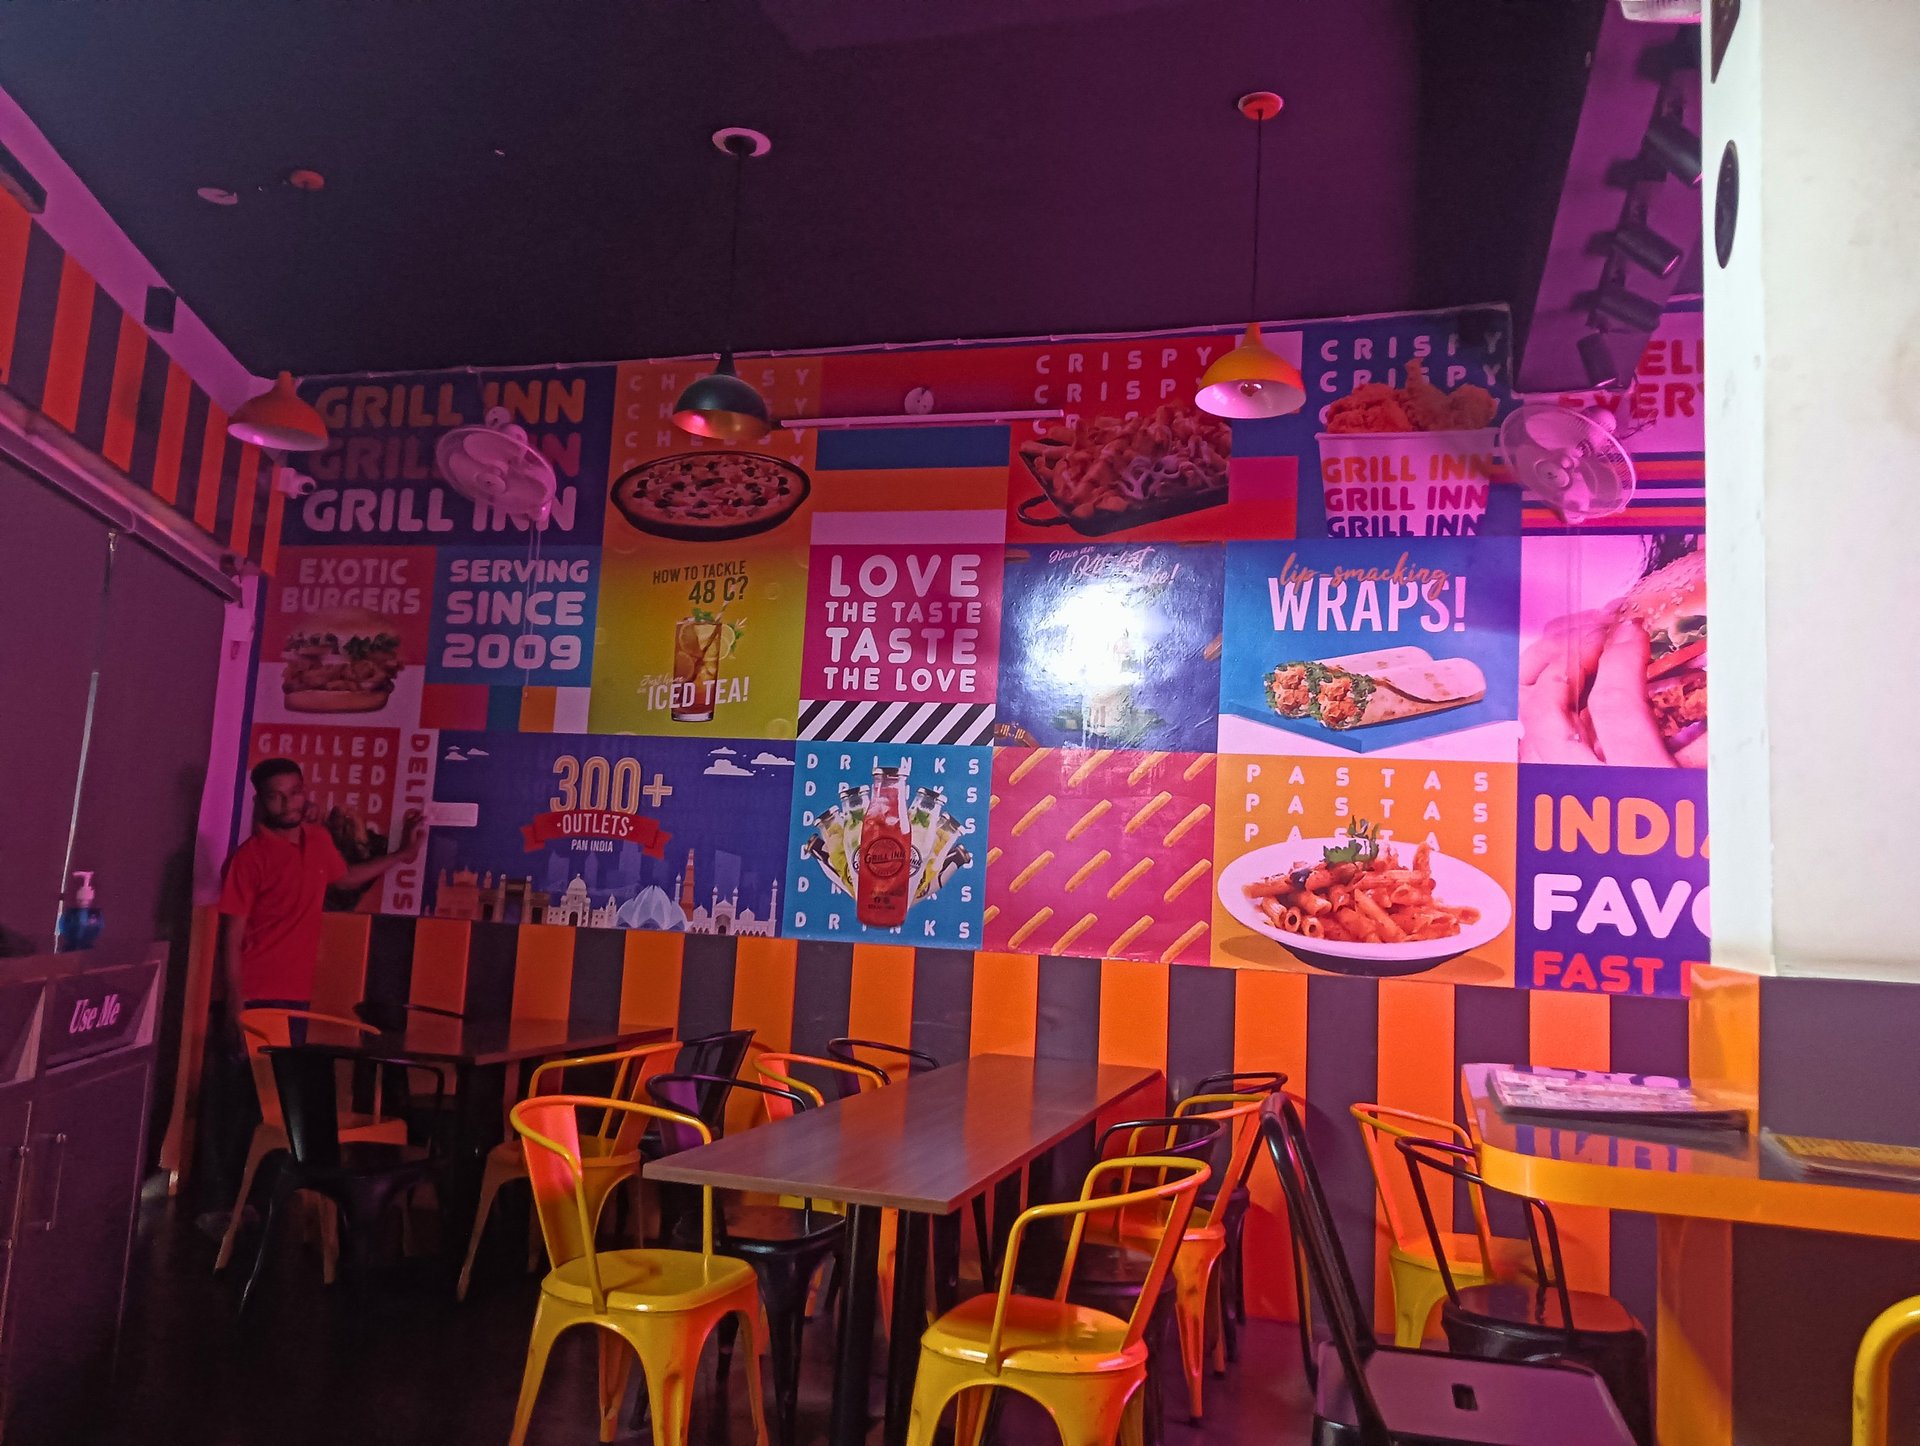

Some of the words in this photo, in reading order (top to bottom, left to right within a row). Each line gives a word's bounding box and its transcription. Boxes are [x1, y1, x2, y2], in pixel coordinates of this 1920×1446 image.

[1036, 346, 1212, 375] CRISPY
[630, 368, 809, 392] CHSY
[1034, 378, 1203, 405] CRISP
[314, 382, 464, 430] GRILL
[1323, 455, 1416, 483] GRILL
[1429, 453, 1493, 481] INN
[303, 487, 454, 533] GRILL
[1325, 486, 1415, 512] GRILL
[1426, 484, 1489, 510] INN
[1327, 515, 1414, 537] GRILL
[1425, 513, 1487, 537] INN
[1049, 549, 1079, 564] Have
[1080, 545, 1096, 555] an
[299, 558, 409, 586] EXOTIC
[449, 559, 590, 583] SERVING
[652, 568, 681, 585] HOW
[684, 565, 699, 581] TO
[702, 560, 747, 579] TACKLE
[829, 554, 981, 598] LOVE
[1279, 551, 1450, 601] lip-smacking
[280, 586, 421, 616] BURGERS
[688, 579, 716, 604] 48
[723, 575, 749, 602] C?
[1268, 576, 1467, 633] WRAPS!
[445, 590, 587, 627] SINCE
[825, 601, 878, 623] THE
[891, 601, 982, 624] TASTE
[441, 633, 583, 670] 2009
[825, 627, 979, 665] TASTE
[647, 682, 696, 711] ICED
[702, 676, 750, 706] TEA!
[823, 667, 881, 691] THE
[895, 668, 977, 693] LOVE
[258, 732, 389, 758] GRILLED
[806, 753, 980, 776] DRINKS
[1246, 763, 1489, 793] PASTAS
[550, 754, 673, 815] 300+
[1245, 793, 1489, 823] PASTAS
[1534, 793, 1709, 859] INDI
[570, 839, 588, 851] PAN
[590, 840, 614, 852] INDIA
[1533, 950, 1665, 996] FAST
[69, 998, 97, 1034] Use
[96, 993, 121, 1028] Me
